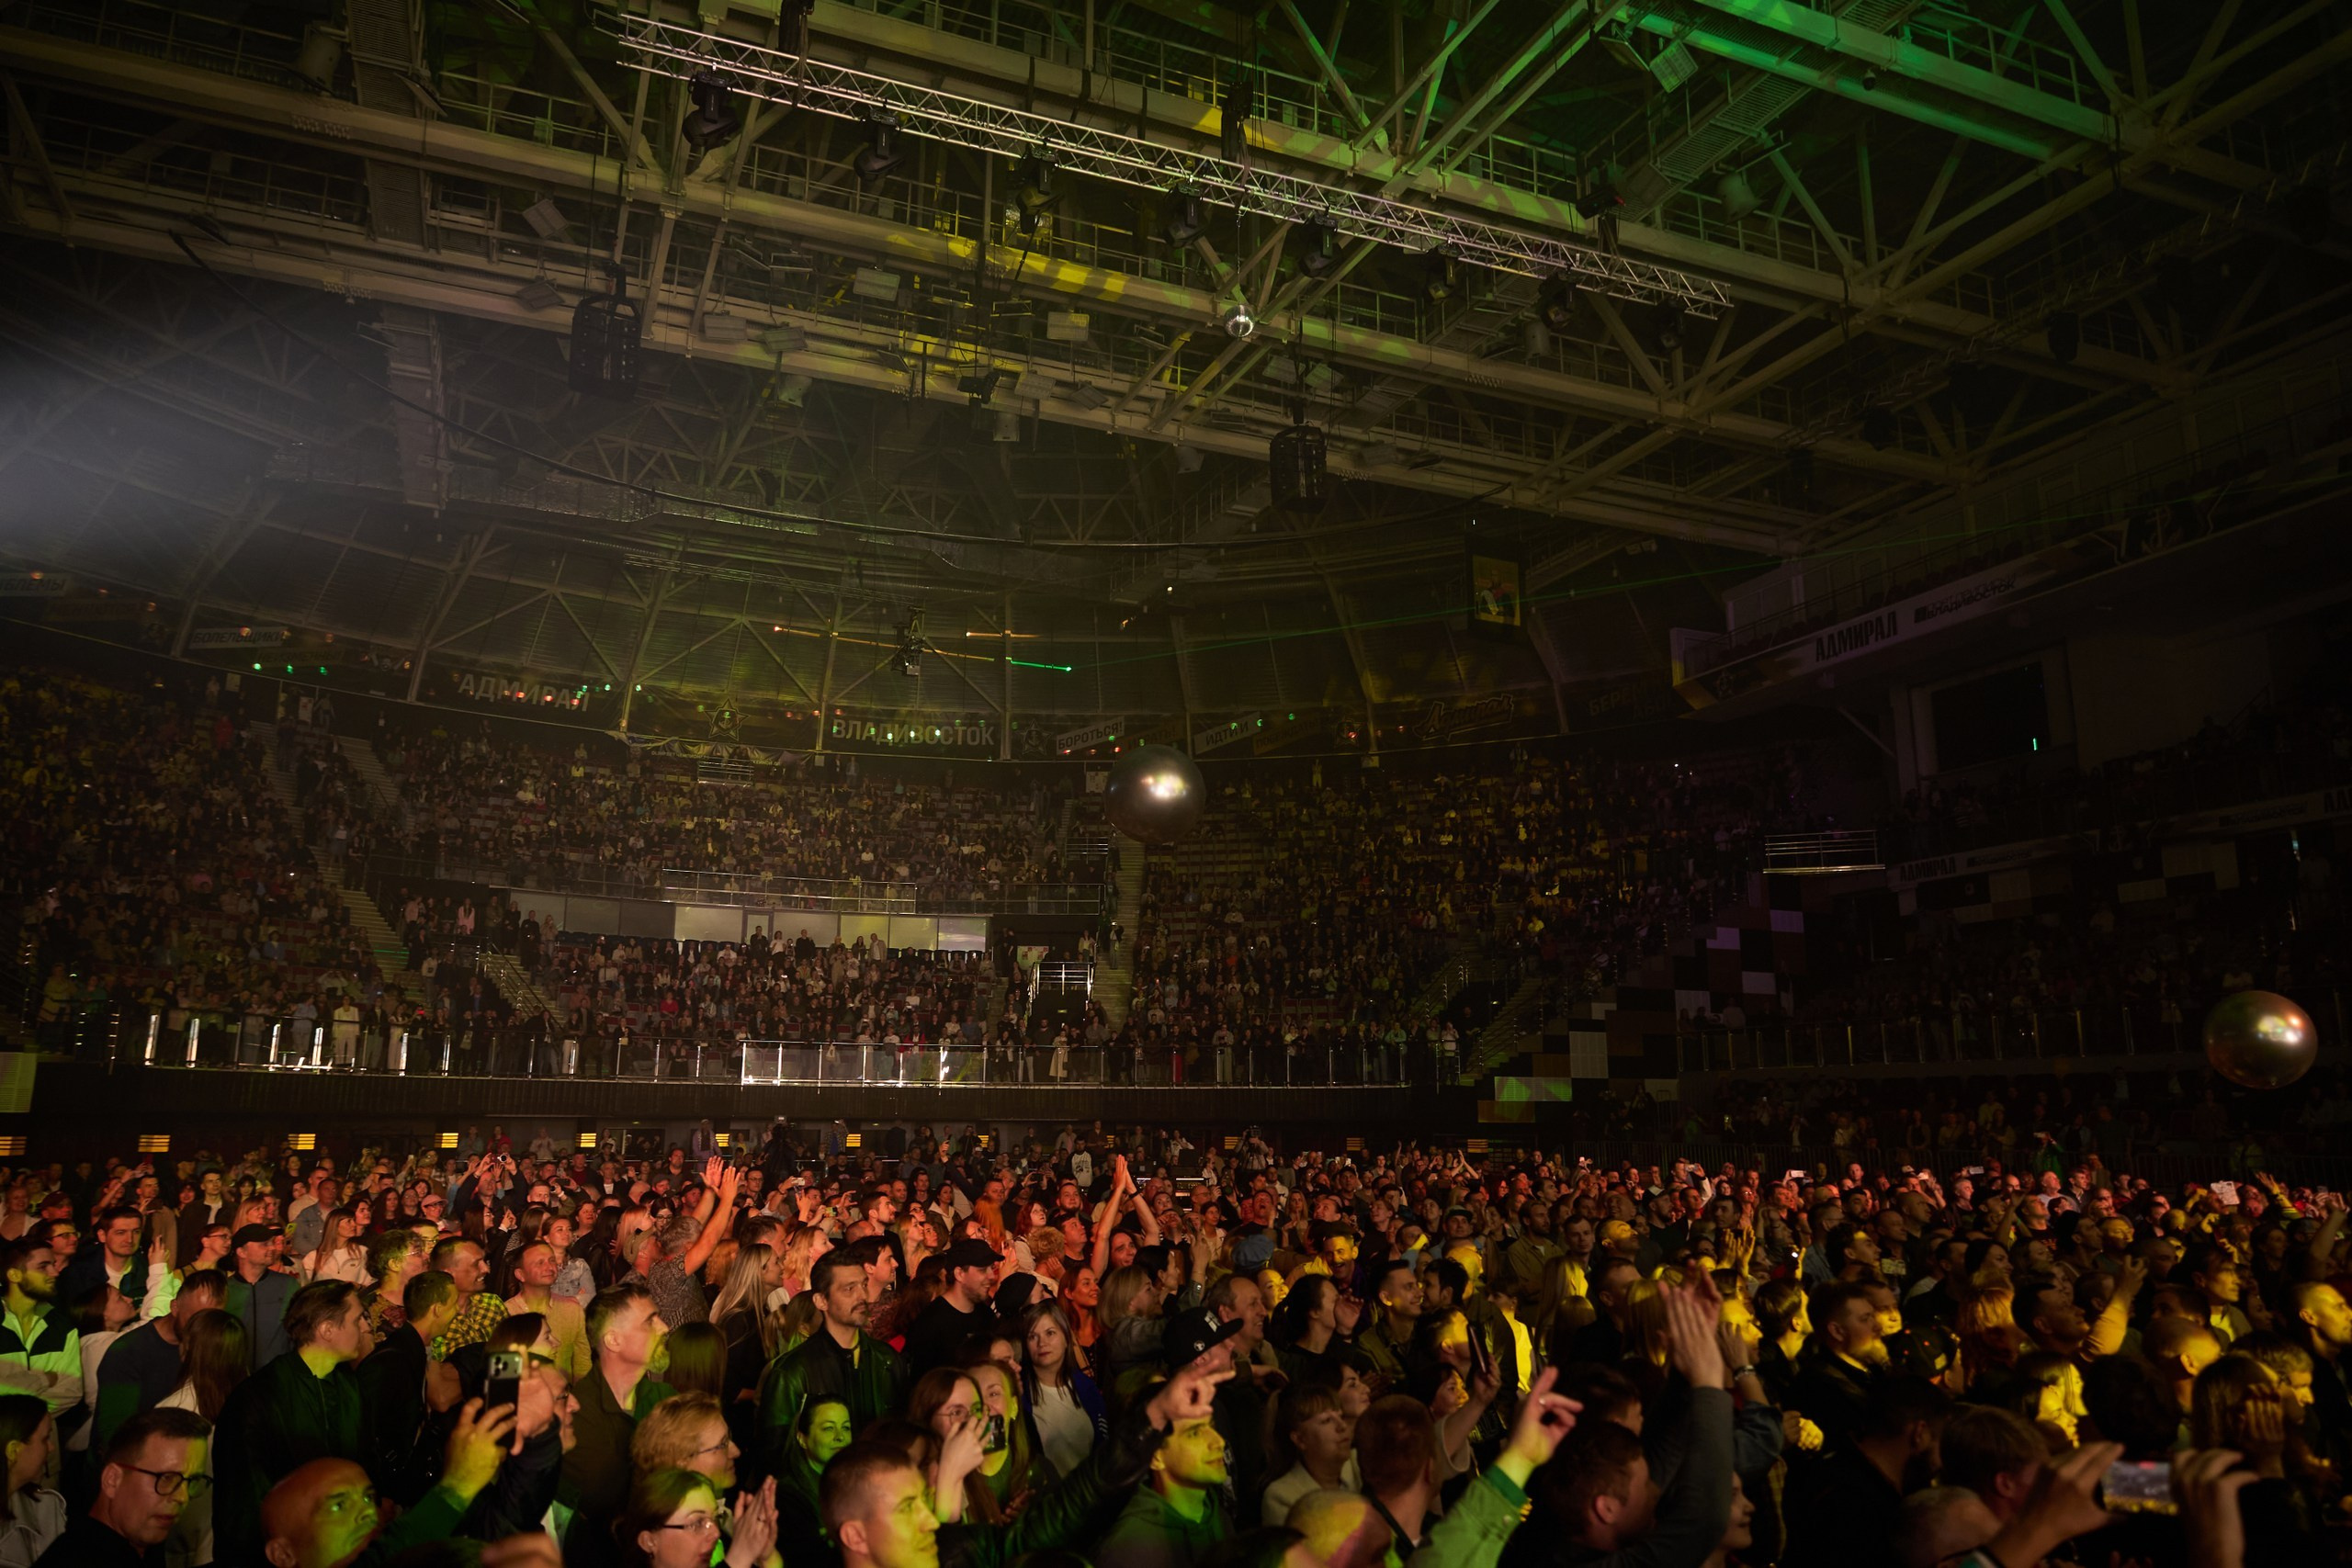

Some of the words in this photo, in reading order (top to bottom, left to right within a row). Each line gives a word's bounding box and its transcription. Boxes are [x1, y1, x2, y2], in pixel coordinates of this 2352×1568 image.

[1815, 611, 1898, 661] АДМИРАЛ
[458, 673, 591, 712] АДМИРАЛ
[832, 719, 995, 746] ВЛАДИВОСТОК
[1058, 722, 1123, 750] БОРОТЬСЯ!
[1900, 856, 1956, 882] АДМИРАЛ
